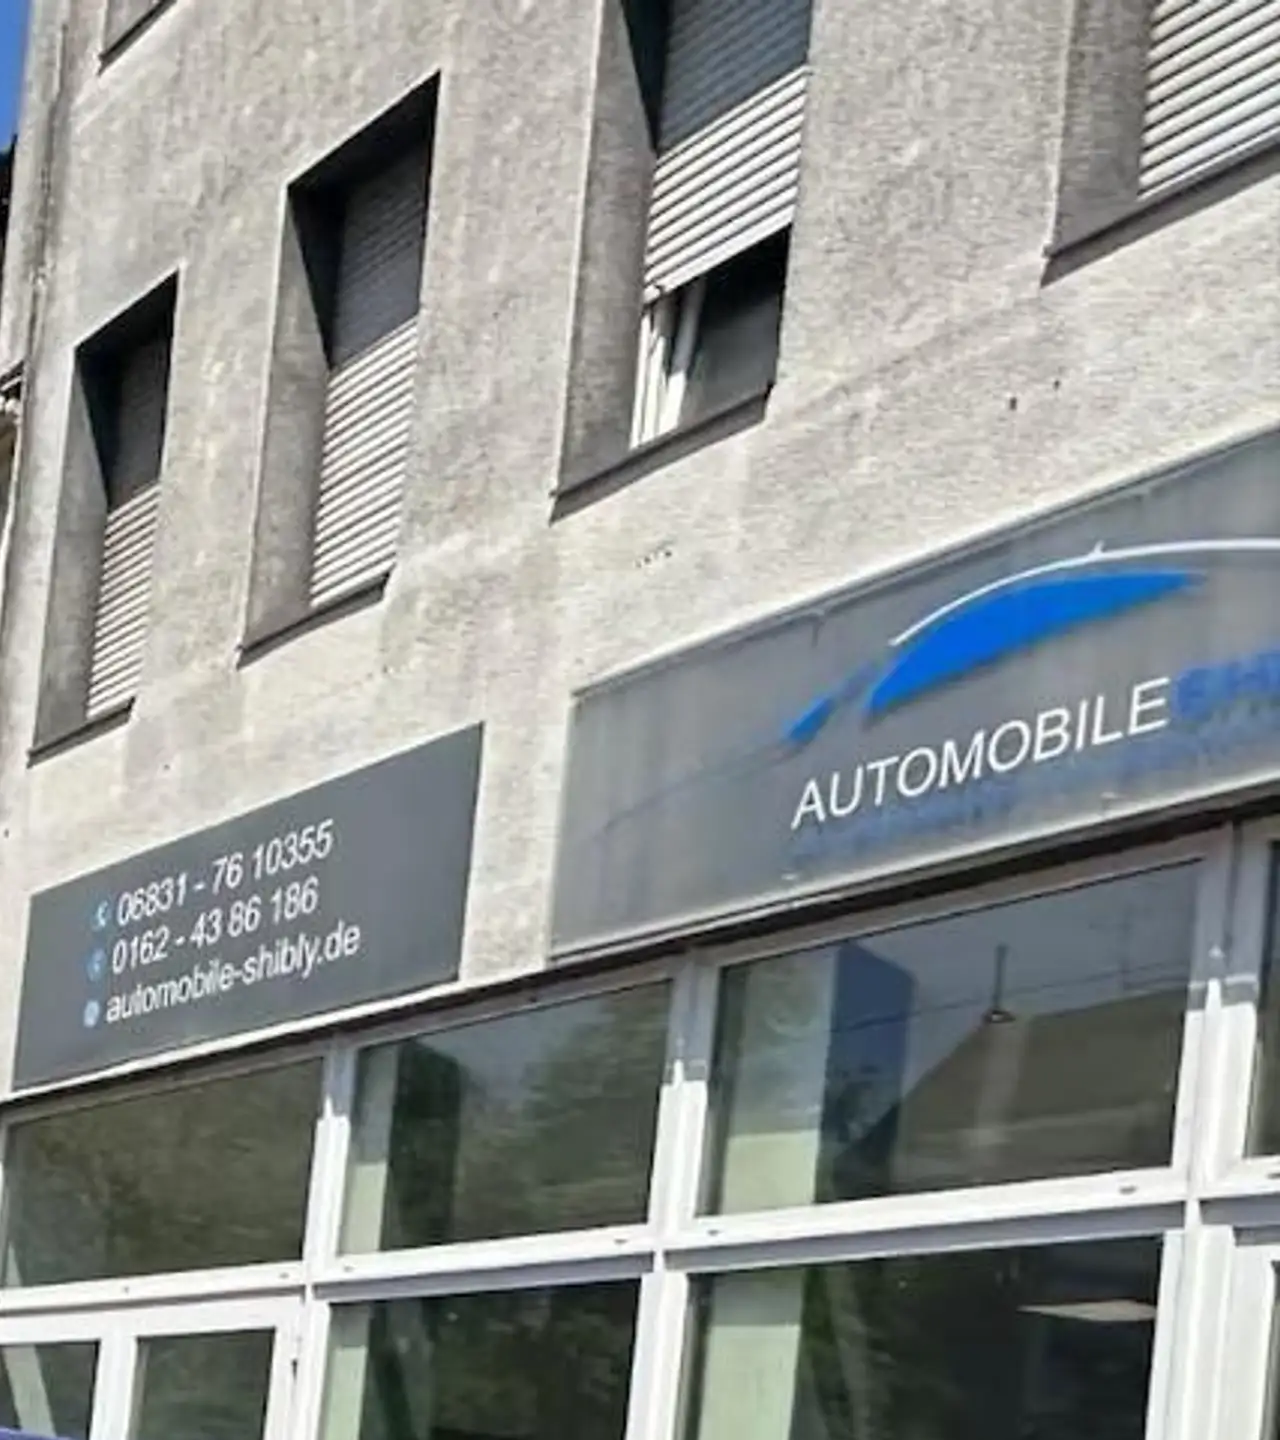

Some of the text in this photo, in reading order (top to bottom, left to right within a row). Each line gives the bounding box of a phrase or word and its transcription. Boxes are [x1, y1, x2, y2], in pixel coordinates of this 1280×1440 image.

[112, 925, 170, 975] 0162
[190, 908, 222, 949] 43
[227, 895, 261, 937] 86
[269, 875, 319, 924] 186
[117, 872, 187, 926] 06831
[212, 852, 244, 894] 76
[252, 818, 333, 880] 10355
[105, 918, 361, 1024] automobile-shibly.de
